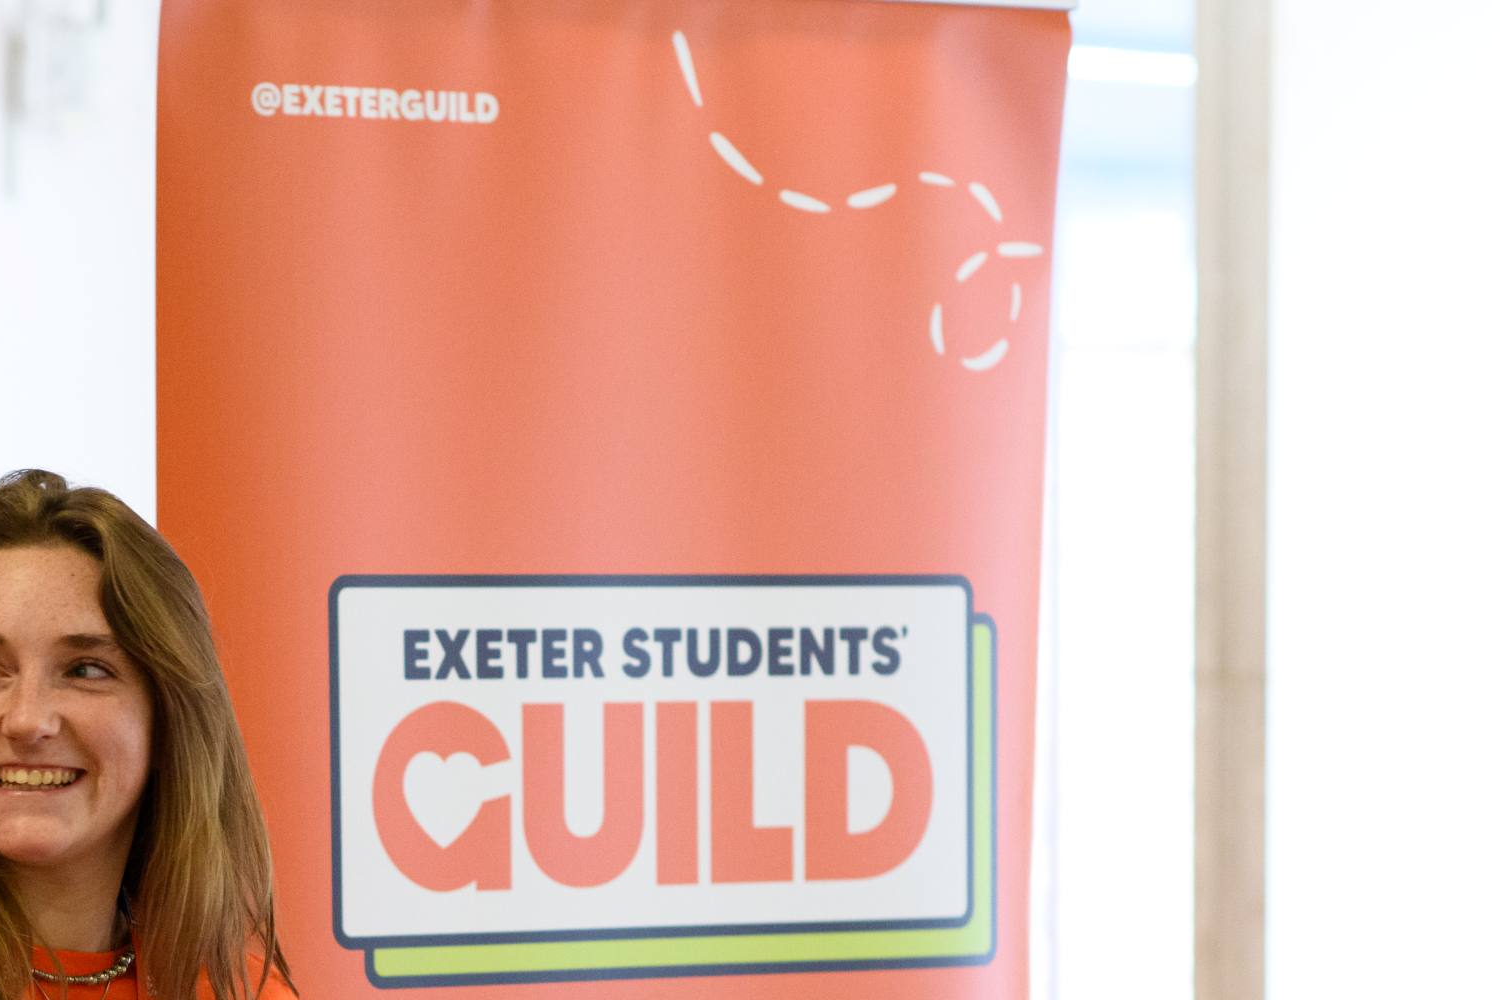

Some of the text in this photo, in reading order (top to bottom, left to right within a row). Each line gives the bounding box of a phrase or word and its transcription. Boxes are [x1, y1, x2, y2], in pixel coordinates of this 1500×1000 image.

[251, 82, 499, 124] @EXETERGUILD
[403, 625, 909, 680] EXETER STUDENTS'
[371, 699, 934, 893] GUILD
